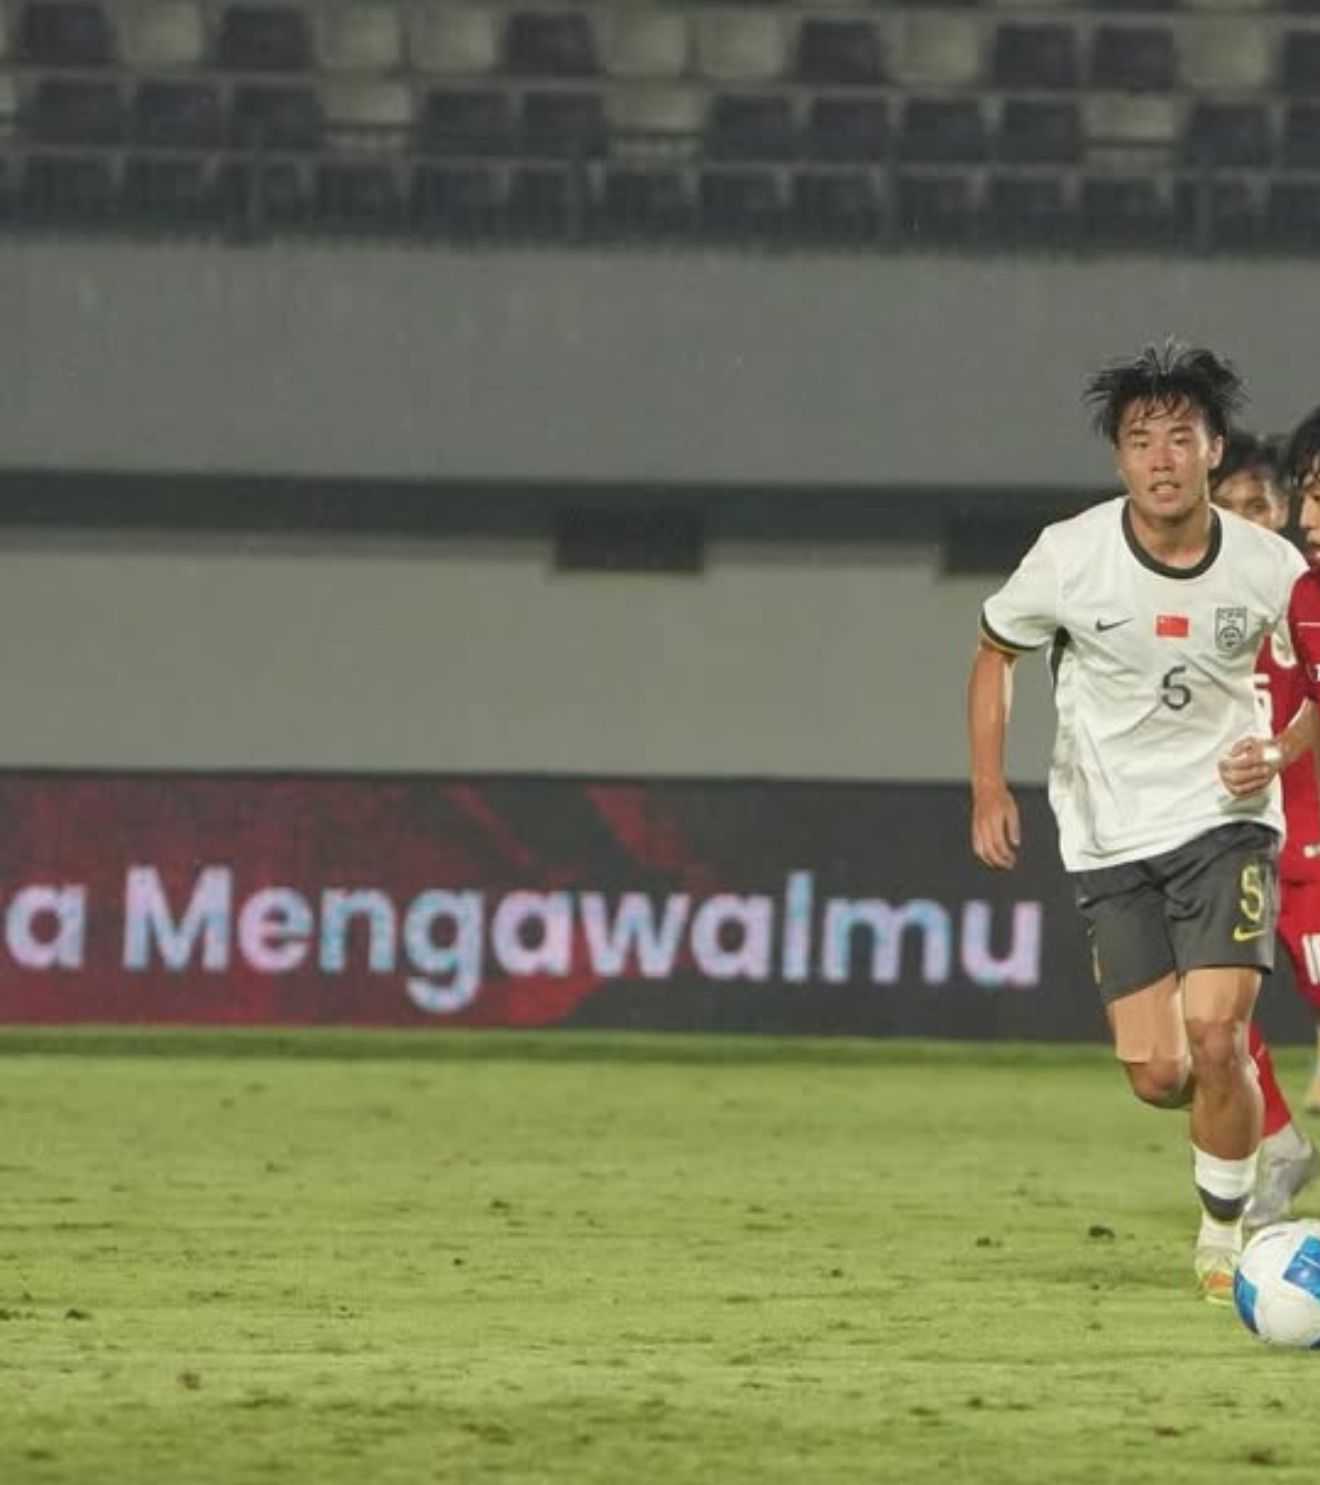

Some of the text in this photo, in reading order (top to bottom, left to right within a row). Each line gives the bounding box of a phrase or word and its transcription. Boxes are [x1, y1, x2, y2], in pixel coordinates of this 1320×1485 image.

[1161, 665, 1192, 711] 5
[1240, 864, 1265, 922] 5
[122, 863, 1042, 1015] Mengawalmu
